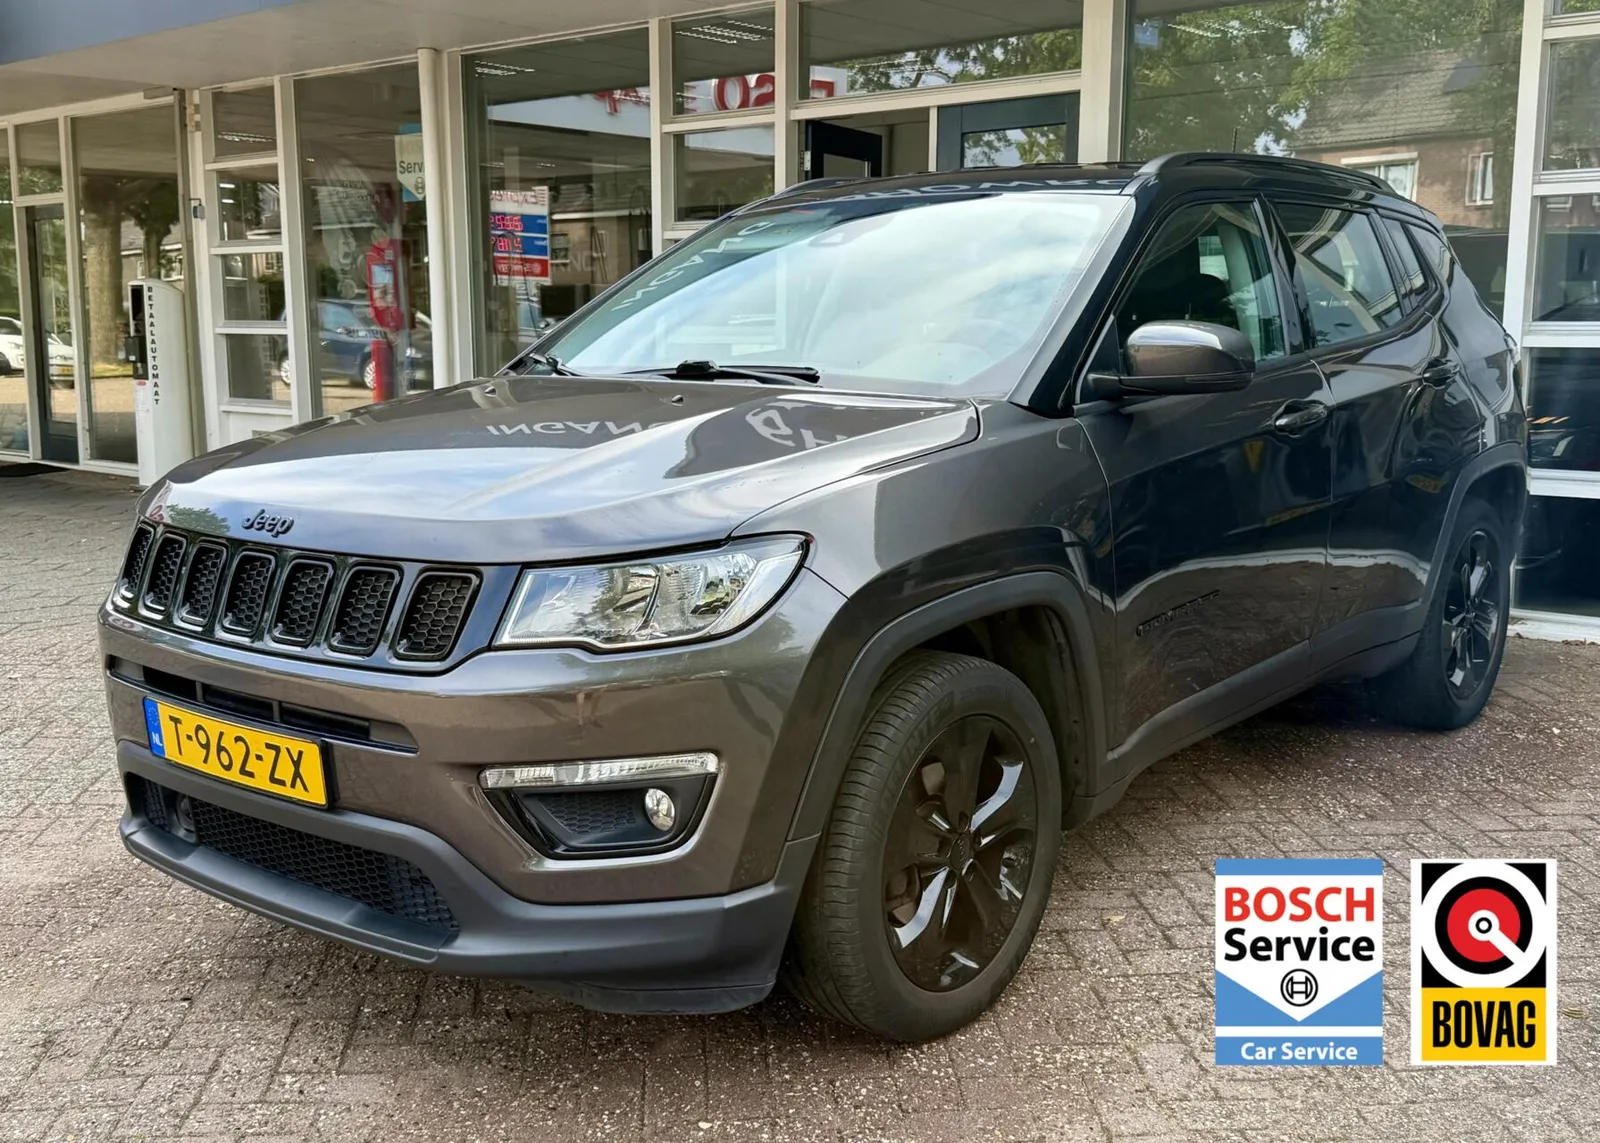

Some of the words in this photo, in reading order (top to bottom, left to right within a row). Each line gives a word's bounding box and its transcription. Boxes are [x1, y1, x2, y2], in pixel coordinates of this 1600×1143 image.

[398, 160, 425, 175] Serv
[147, 286, 160, 405] BETAALAUTOMAAT
[242, 509, 294, 538] Jeep
[152, 733, 163, 747] NL
[169, 715, 309, 793] T-962-ZX
